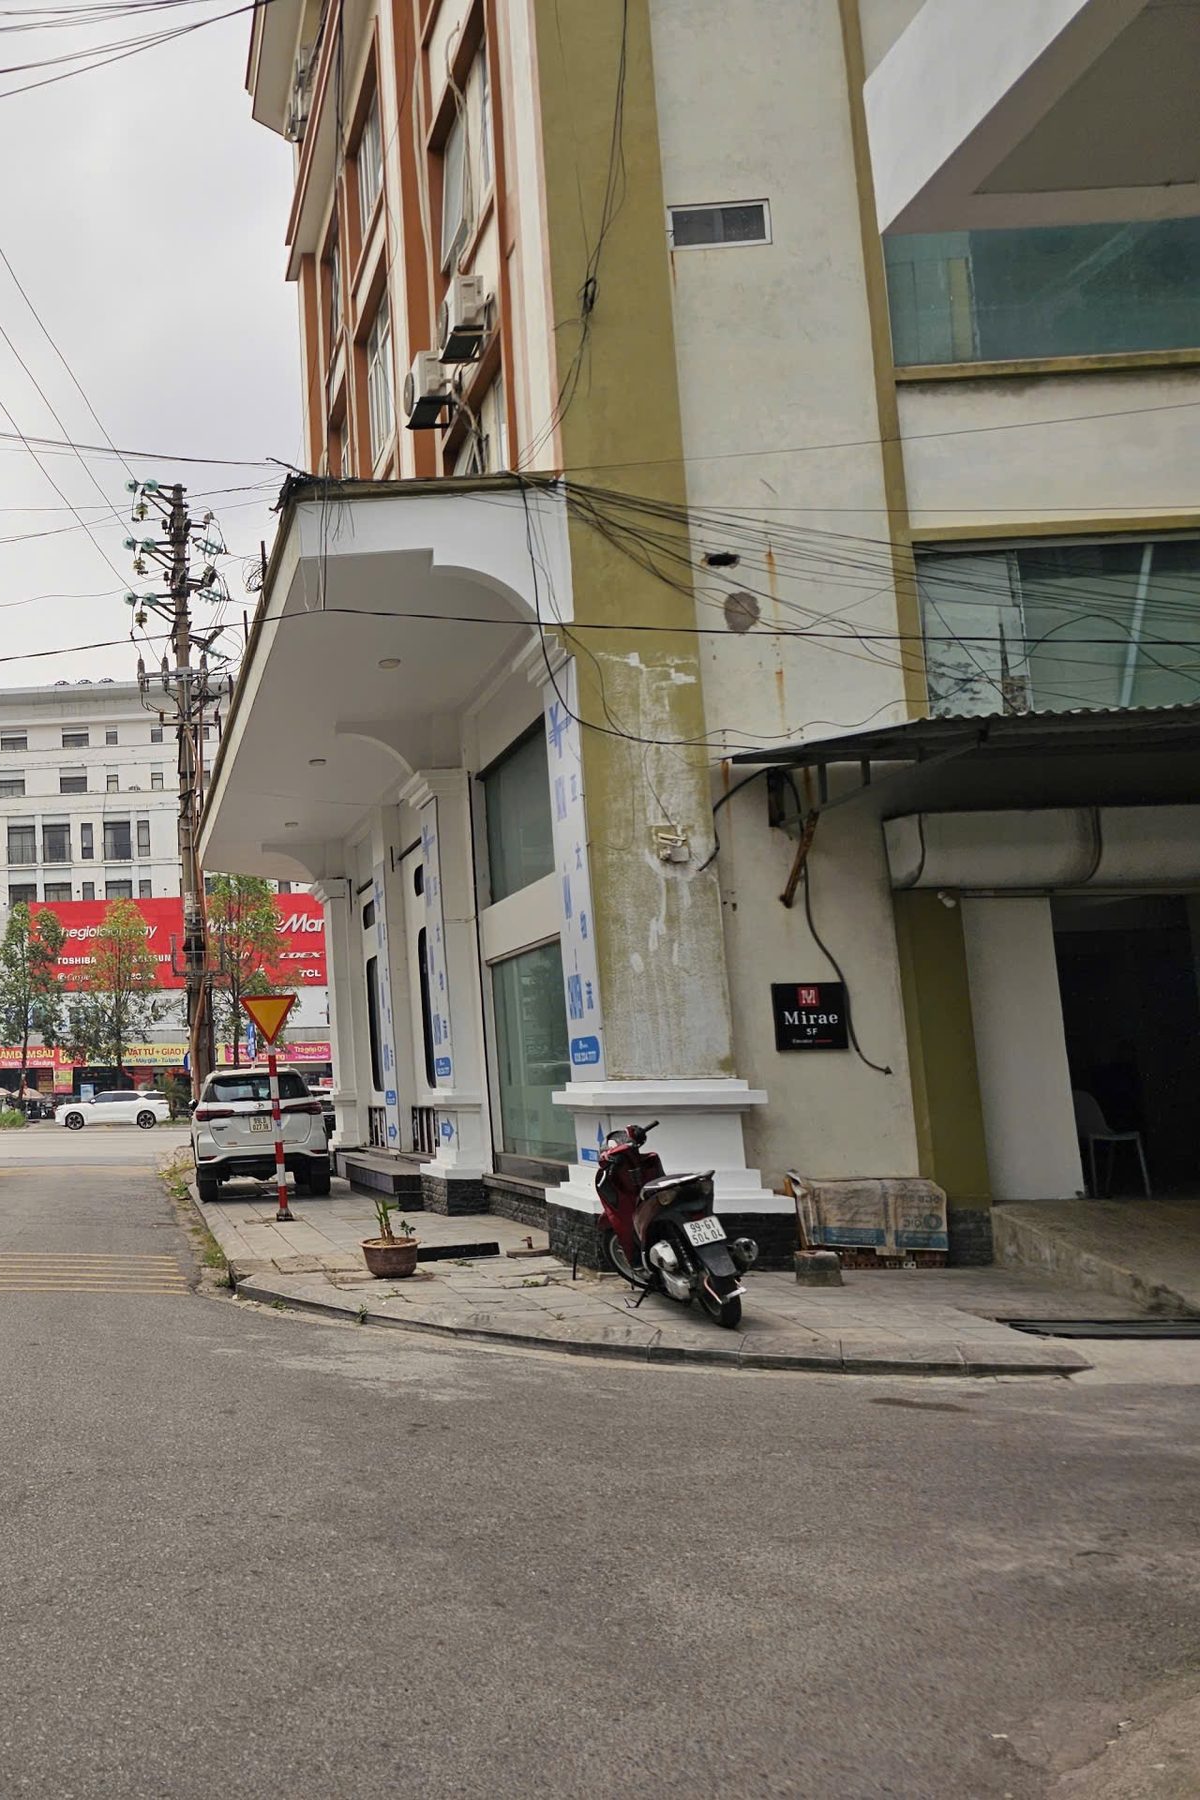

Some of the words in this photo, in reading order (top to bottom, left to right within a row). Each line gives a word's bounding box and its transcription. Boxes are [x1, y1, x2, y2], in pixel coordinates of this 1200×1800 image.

[279, 913, 325, 933] Mar
[57, 956, 97, 965] TOSHIBA
[299, 969, 322, 977] TCL
[783, 1011, 839, 1025] Mirae
[806, 1027, 818, 1036] SF
